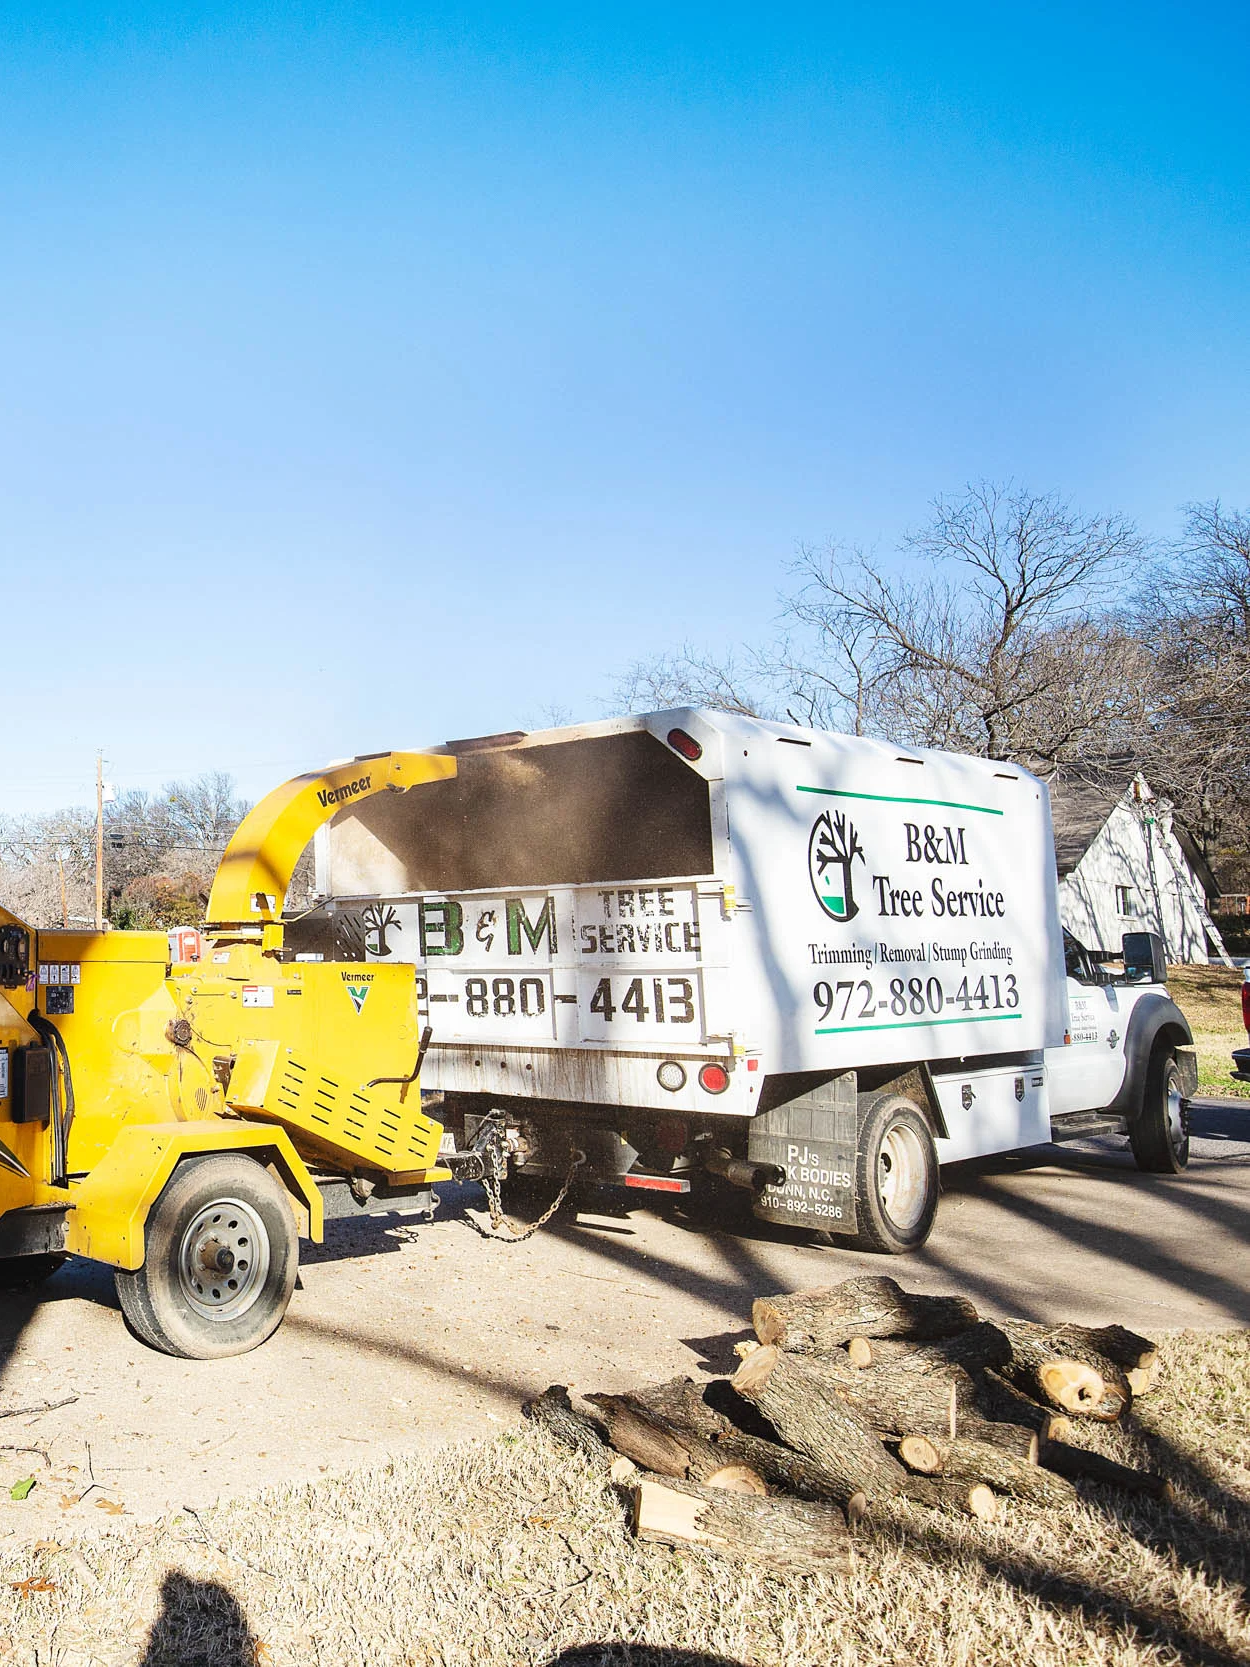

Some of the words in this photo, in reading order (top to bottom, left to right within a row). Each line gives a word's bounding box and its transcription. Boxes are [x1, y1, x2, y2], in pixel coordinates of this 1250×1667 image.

[316, 776, 371, 808] Vermeer
[903, 822, 969, 865] B&M
[597, 888, 675, 919] TREE
[872, 875, 924, 917] Tree
[931, 877, 1006, 917] Service
[419, 900, 465, 957] B
[504, 896, 558, 956] M
[580, 921, 701, 954] SERVICE
[808, 943, 873, 970] Trimming
[879, 942, 927, 962] Removal
[932, 943, 968, 967] Stump
[969, 941, 1013, 966] Grinding
[341, 971, 375, 982] Vermeer
[812, 973, 1020, 1022] 972-880-4413
[800, 1167, 851, 1188] BODIES
[761, 1196, 843, 1218] 910-892-5286
[808, 1187, 834, 1202] N.C.
